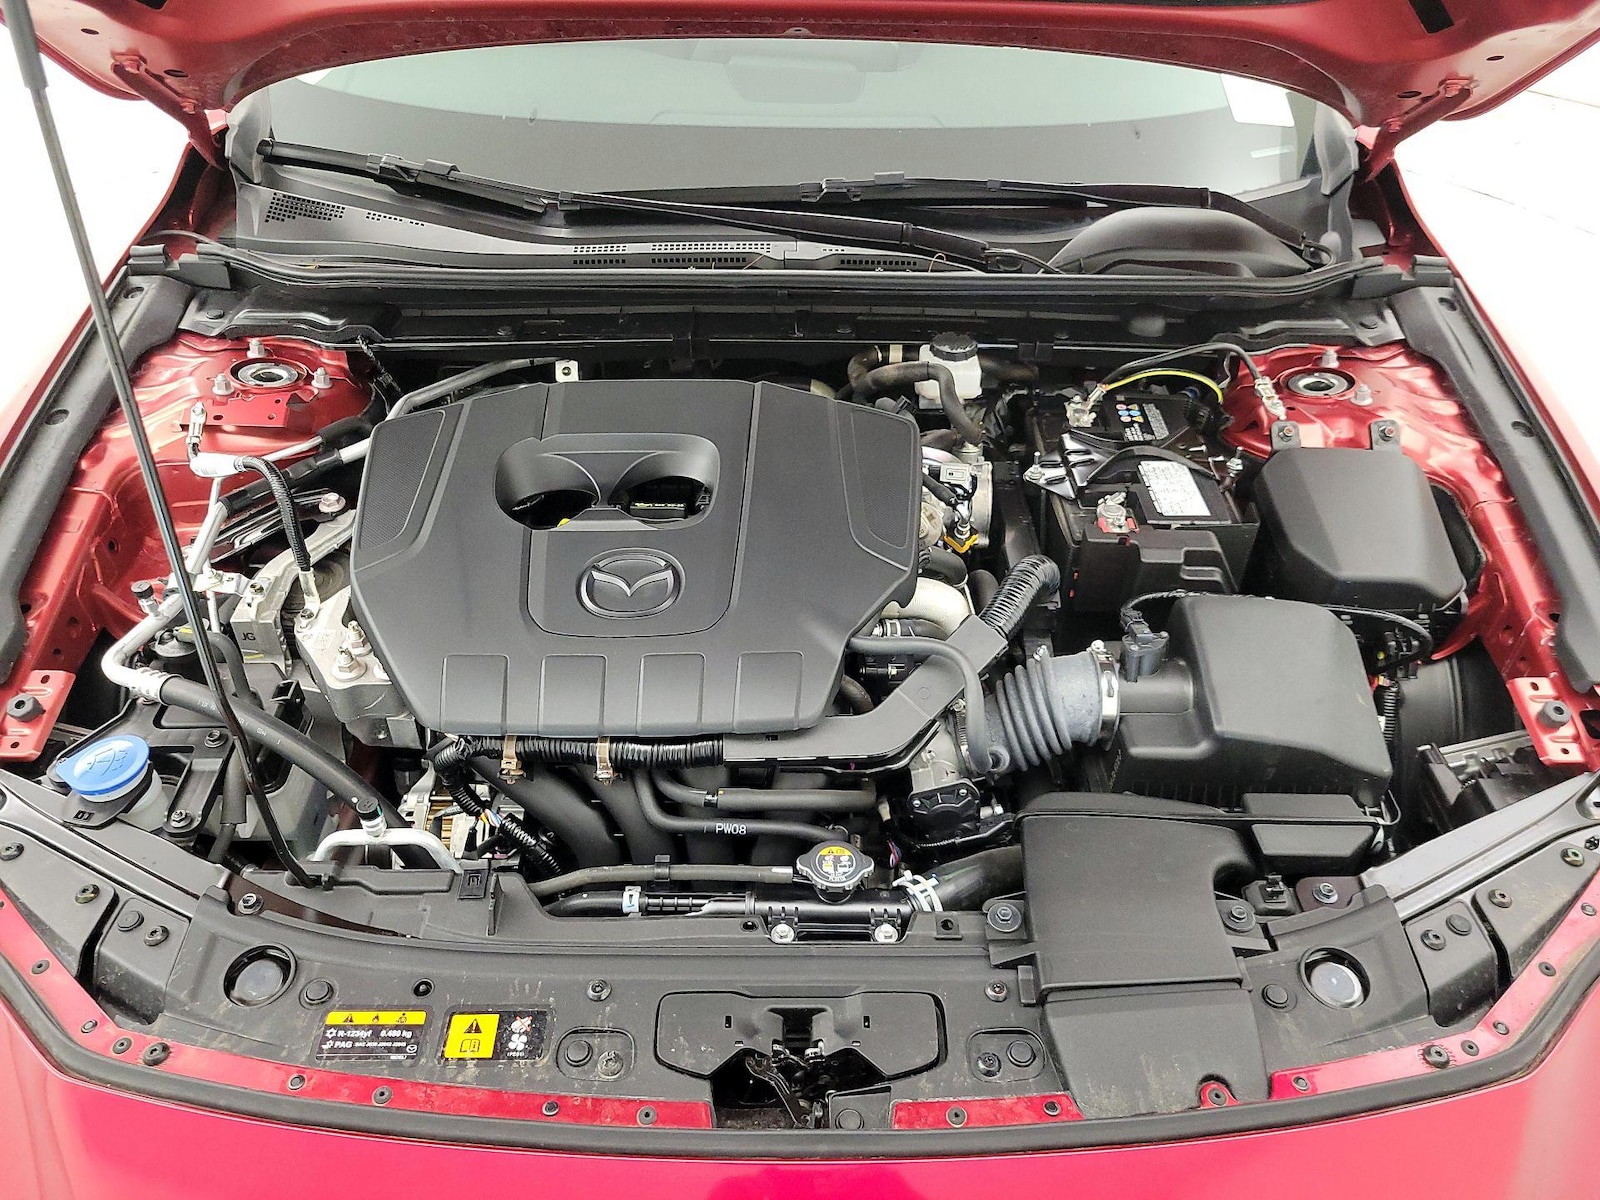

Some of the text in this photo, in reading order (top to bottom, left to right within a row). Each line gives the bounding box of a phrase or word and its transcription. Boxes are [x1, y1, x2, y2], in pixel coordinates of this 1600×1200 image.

[242, 632, 256, 641] JG
[715, 823, 747, 835] PW08
[337, 1030, 372, 1039] R-1234yf
[402, 1029, 413, 1039] kg
